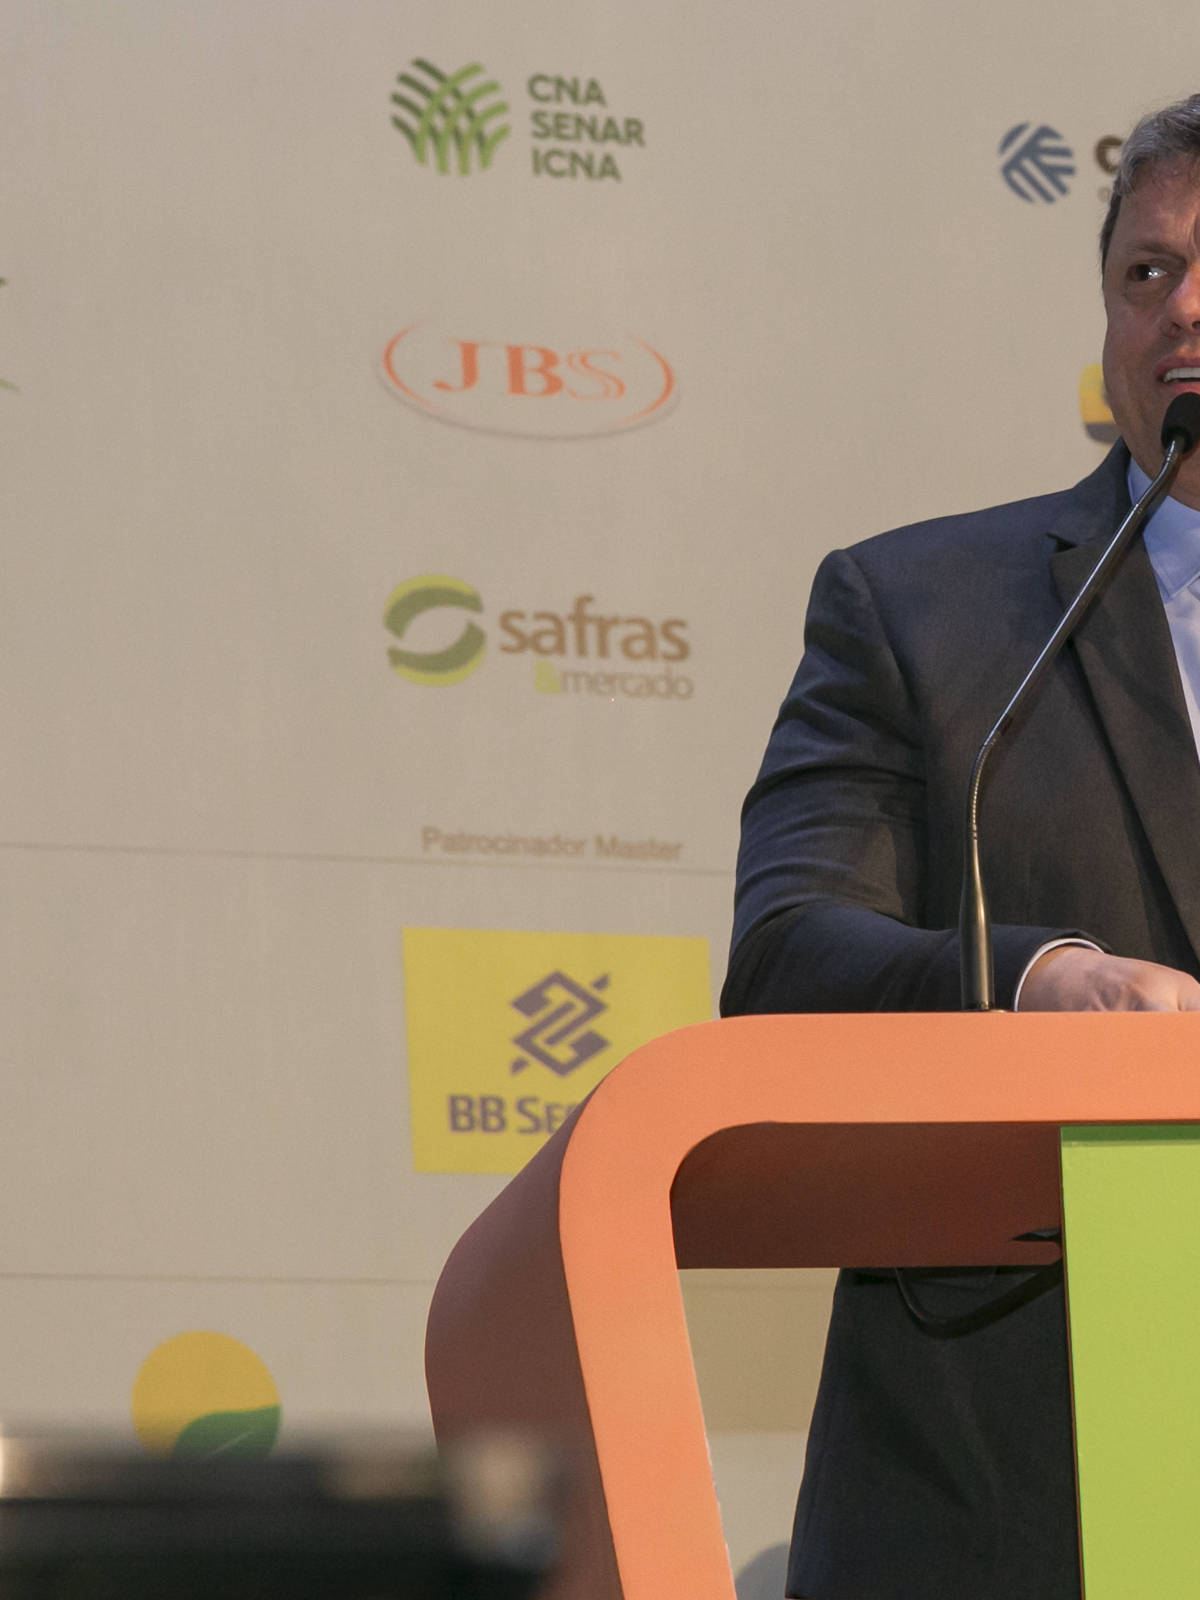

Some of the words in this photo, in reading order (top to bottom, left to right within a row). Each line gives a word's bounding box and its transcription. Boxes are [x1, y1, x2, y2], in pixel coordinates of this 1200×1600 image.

[527, 74, 606, 107] CNA
[530, 111, 646, 147] SENAR
[531, 147, 622, 182] ICNA
[432, 338, 627, 401] JBS
[499, 593, 690, 662] safras
[420, 826, 587, 858] Patrocinador
[595, 835, 683, 861] Master
[448, 1094, 507, 1134] BB
